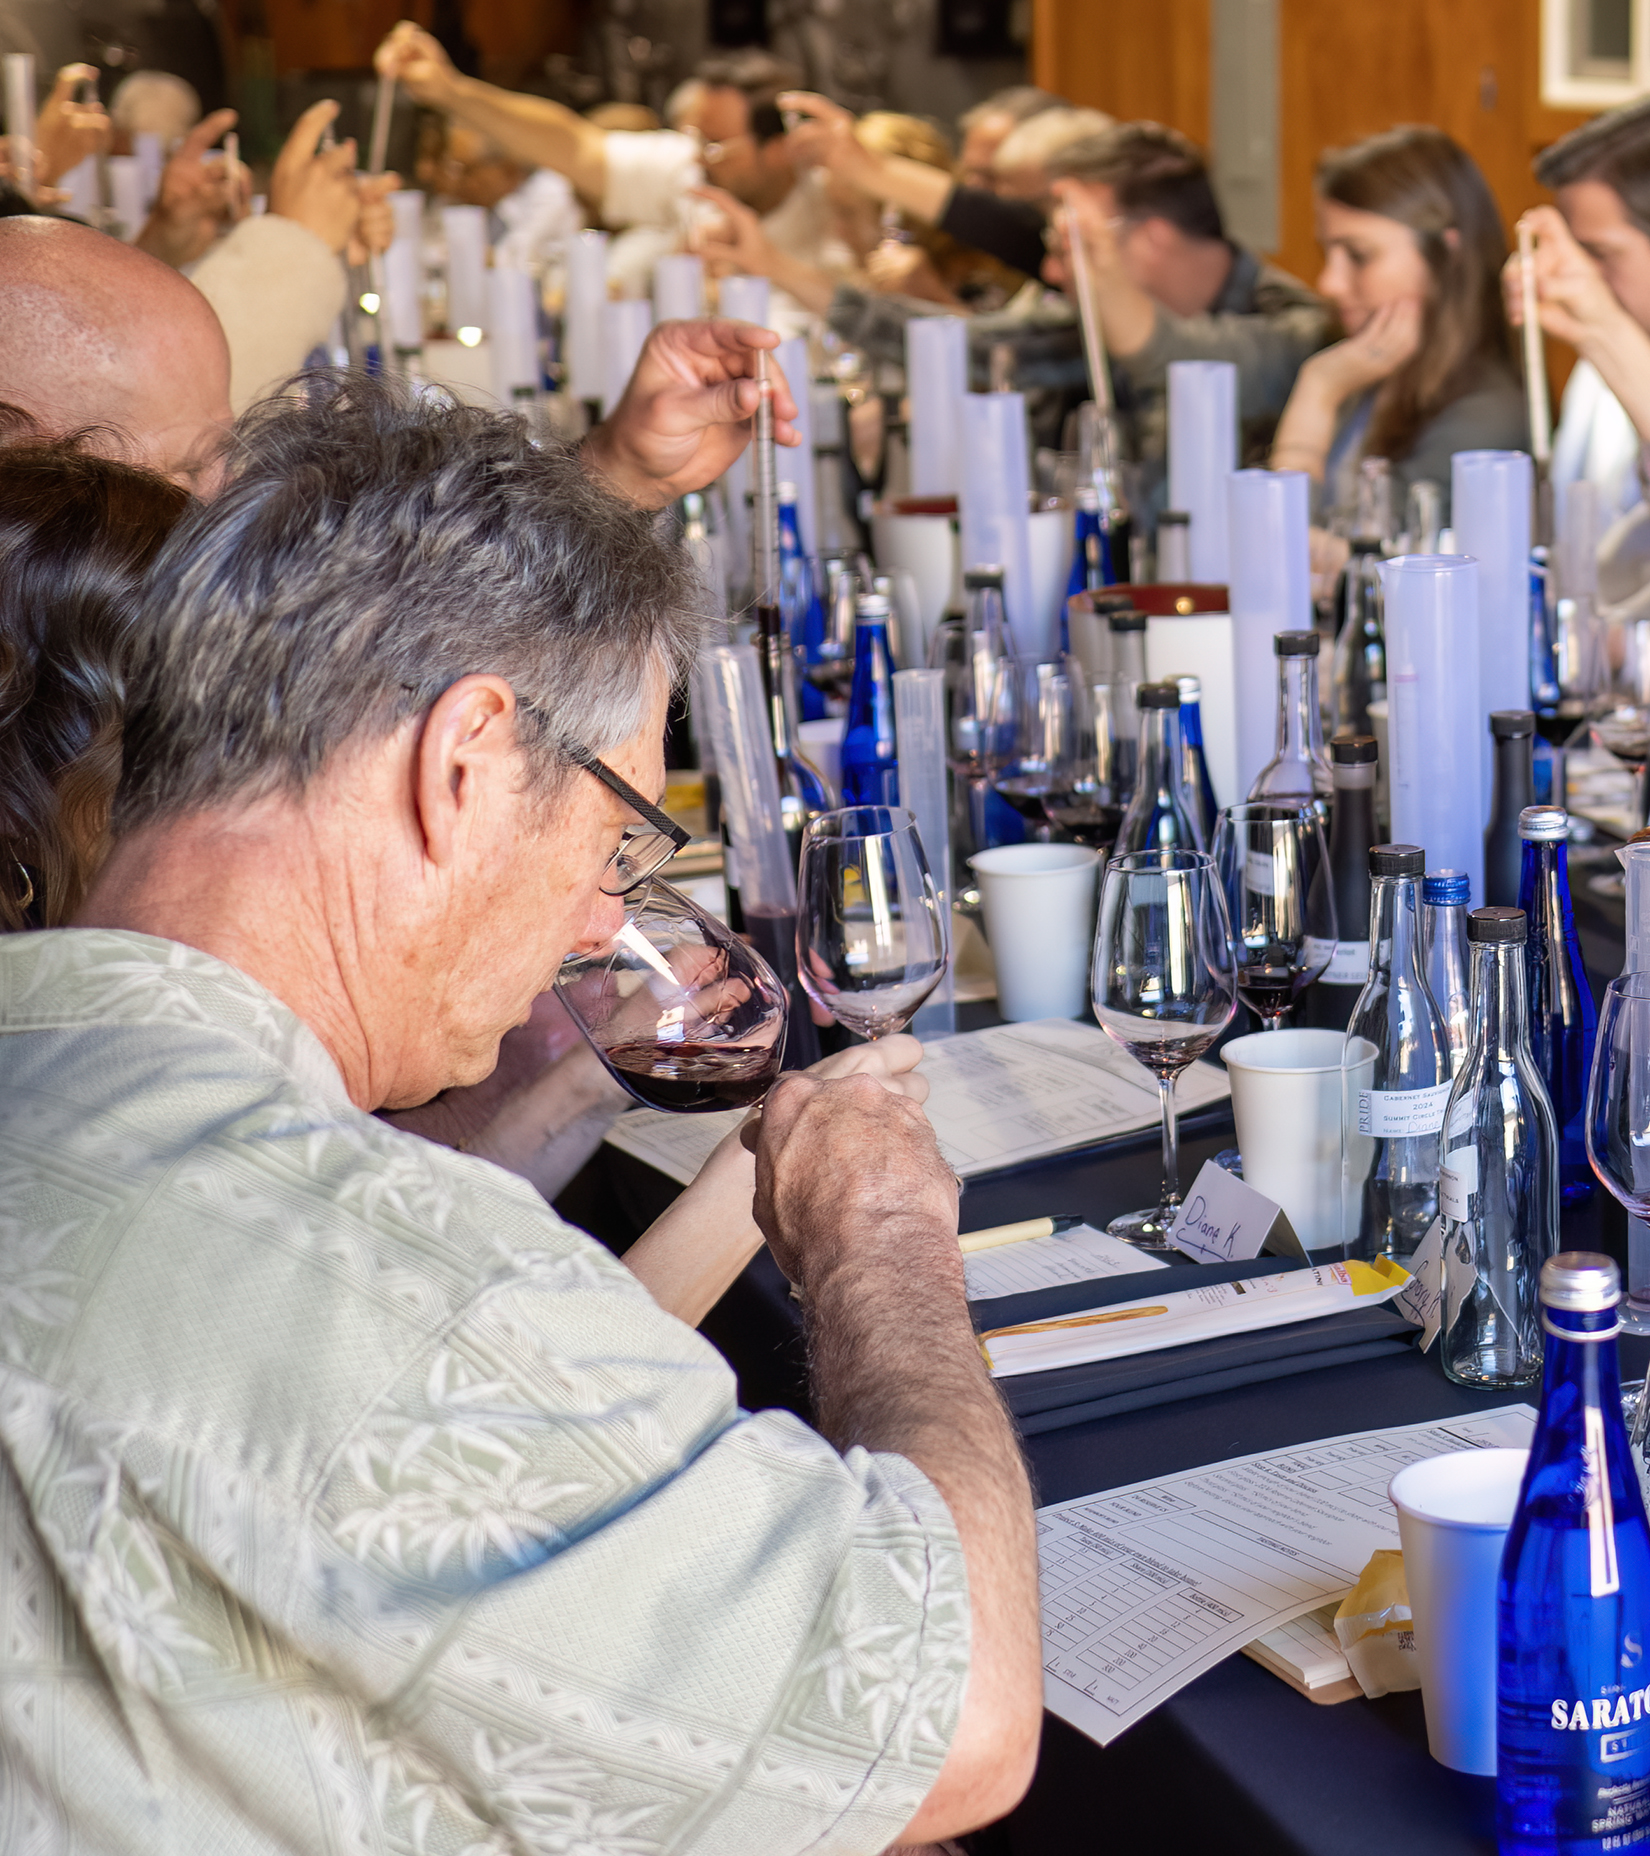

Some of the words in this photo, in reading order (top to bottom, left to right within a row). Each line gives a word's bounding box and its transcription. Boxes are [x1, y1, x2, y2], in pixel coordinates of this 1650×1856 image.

[1359, 1092, 1370, 1133] PRIDE
[1184, 1195, 1221, 1245] Diane
[1591, 1812, 1634, 1834] SPRING
